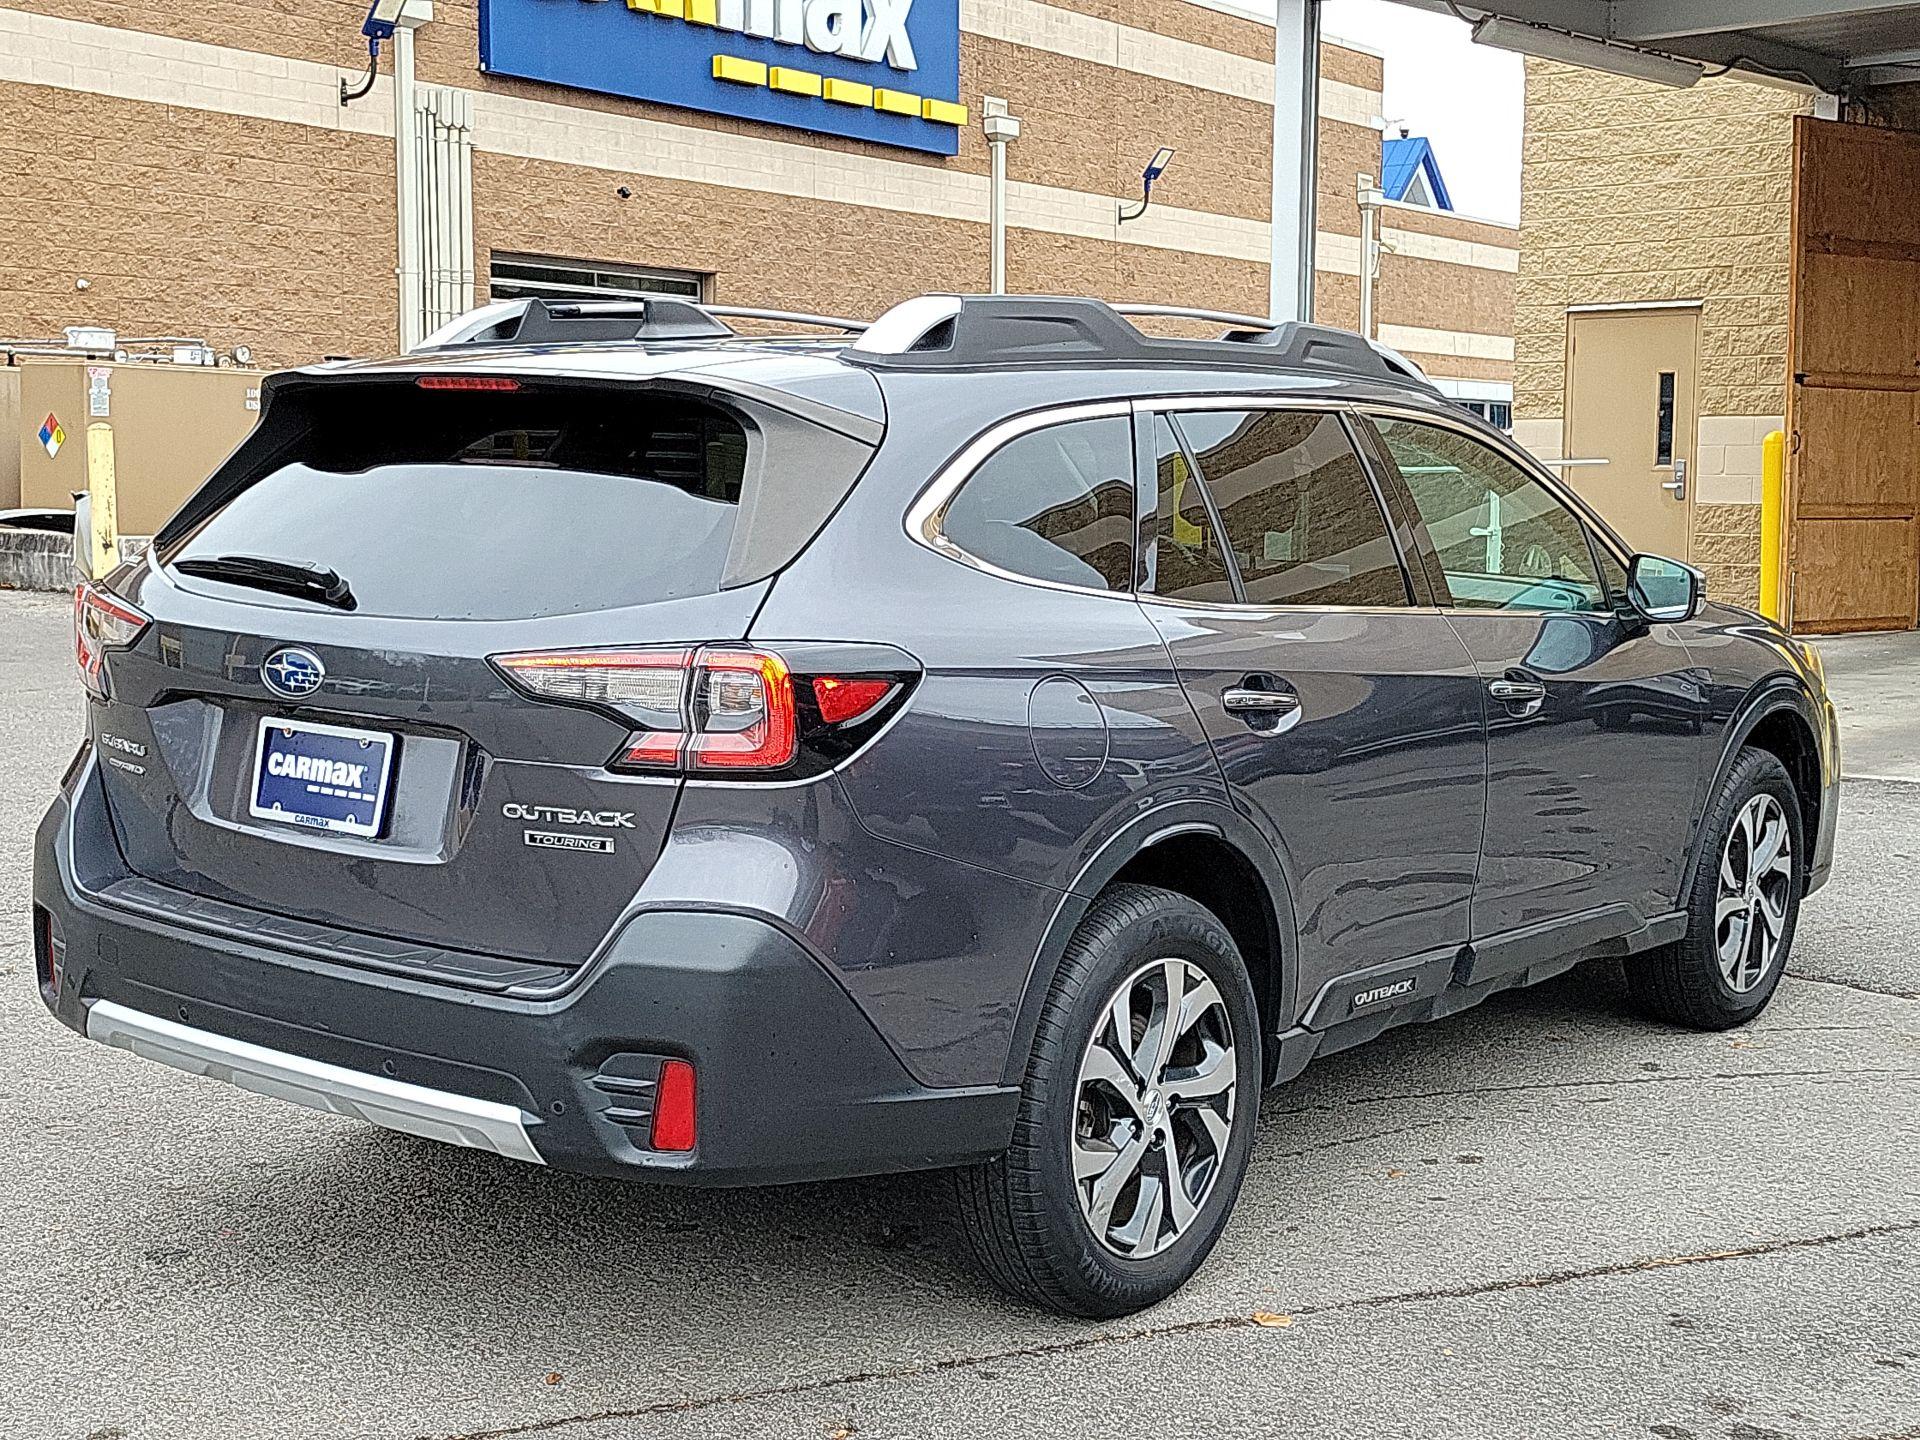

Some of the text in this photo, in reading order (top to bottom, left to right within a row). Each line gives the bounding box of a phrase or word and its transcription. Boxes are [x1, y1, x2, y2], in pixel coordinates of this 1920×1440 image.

[101, 732, 146, 757] SUBARU
[502, 803, 636, 829] OUTBACK
[533, 835, 602, 849] TOURING
[1354, 979, 1414, 1006] OUTBACK
